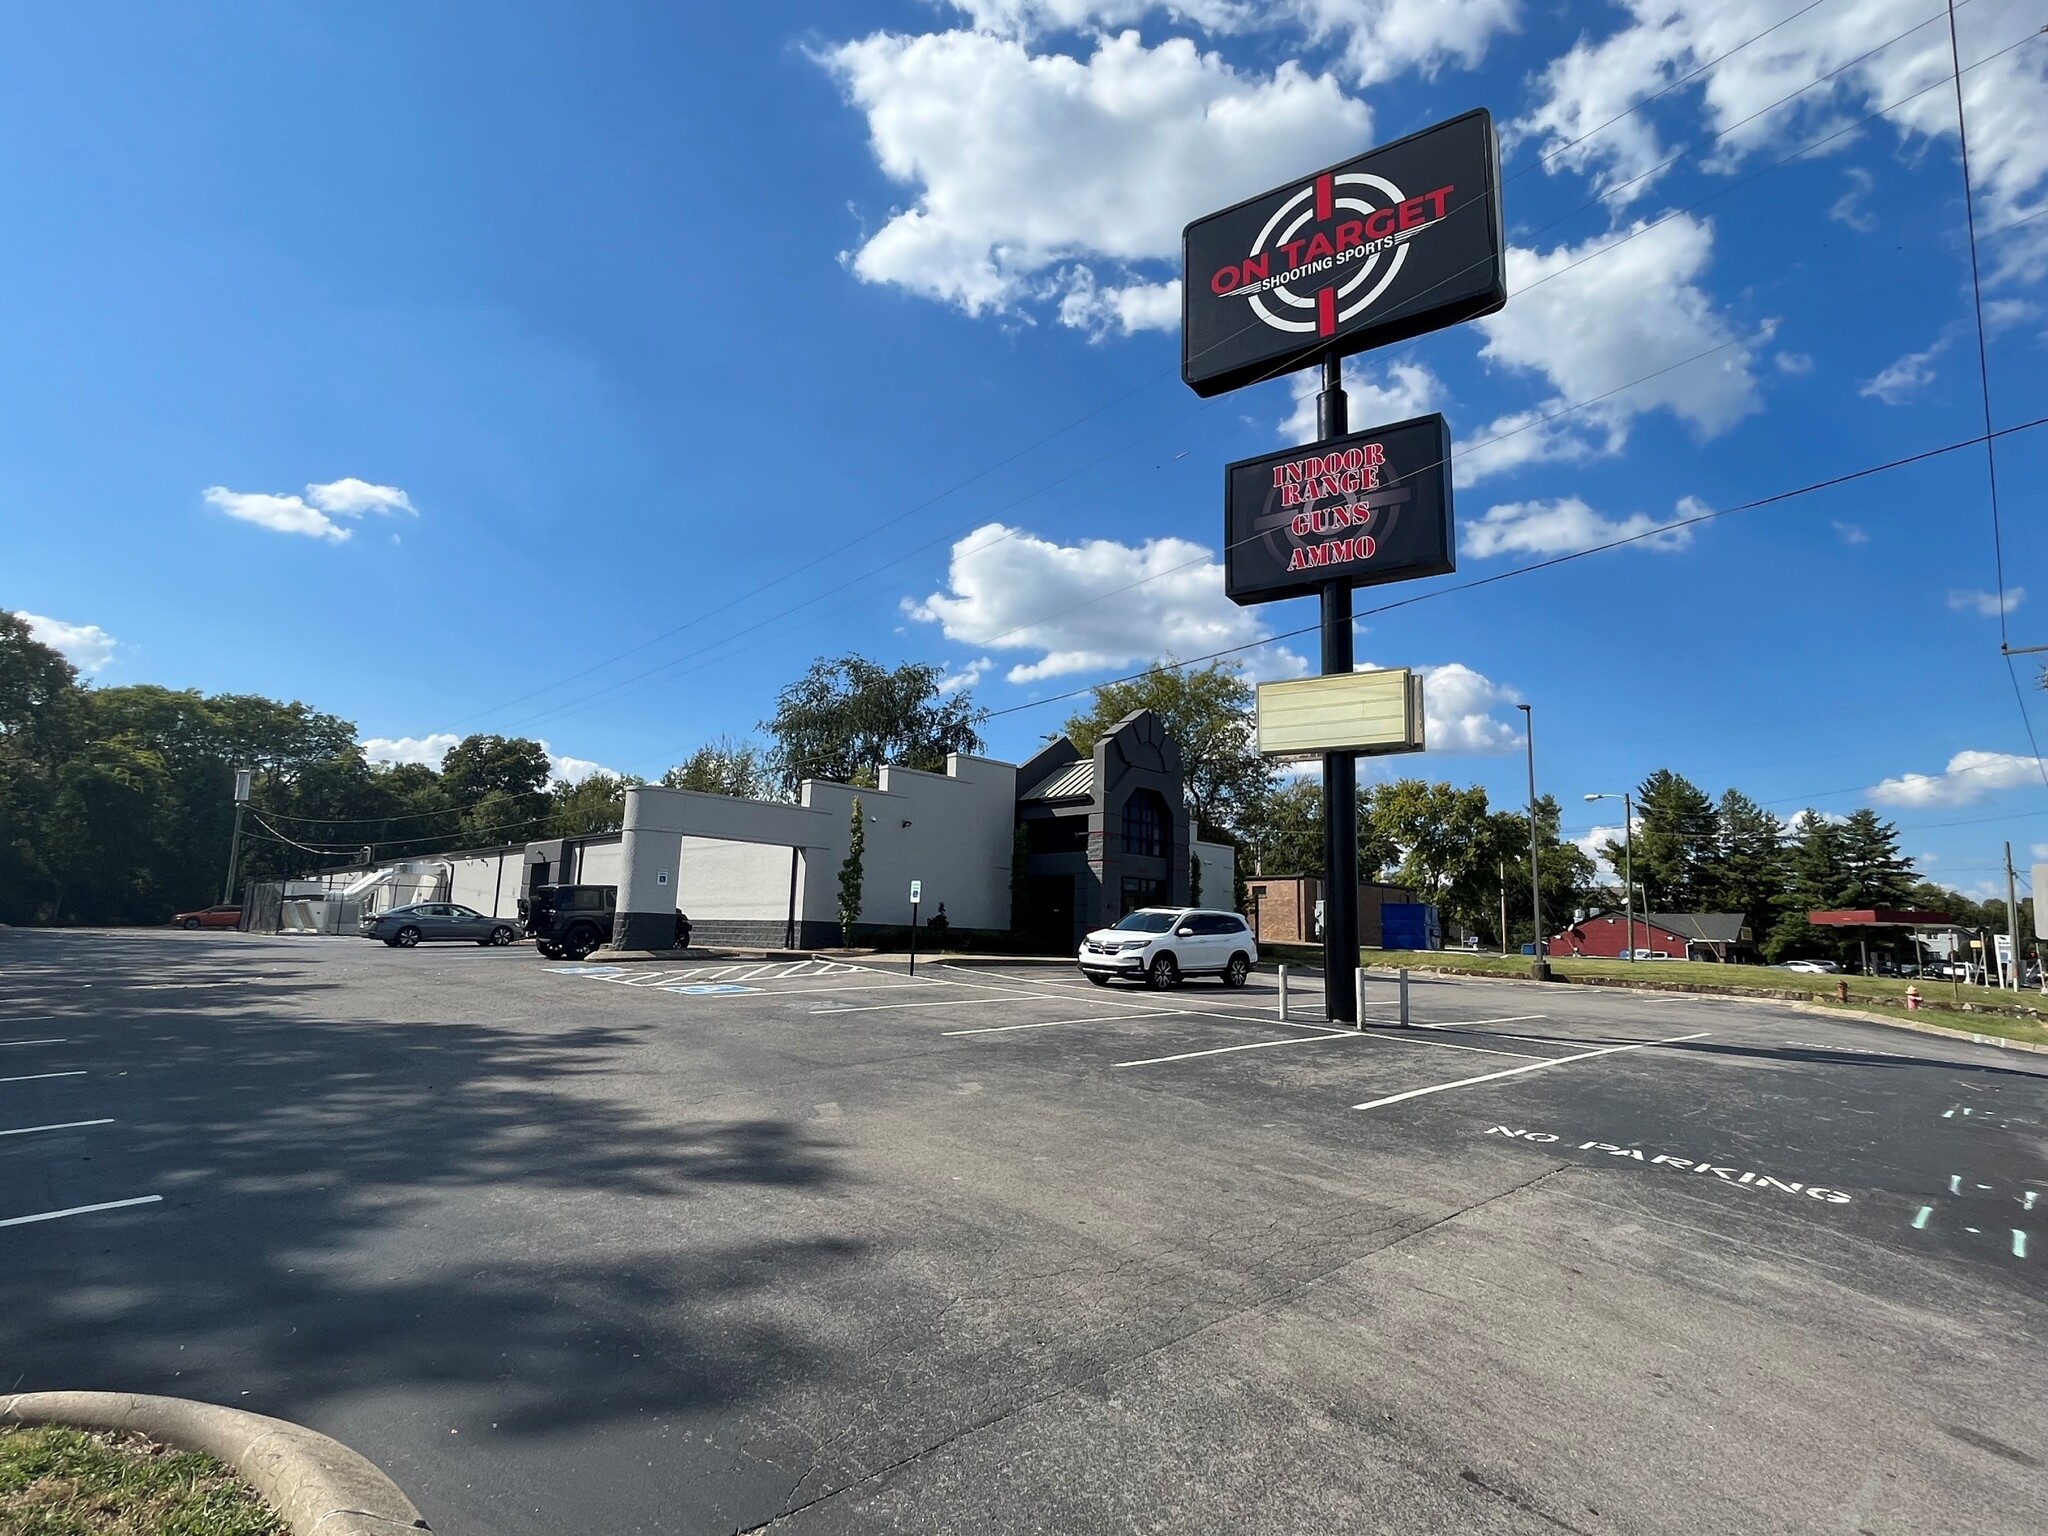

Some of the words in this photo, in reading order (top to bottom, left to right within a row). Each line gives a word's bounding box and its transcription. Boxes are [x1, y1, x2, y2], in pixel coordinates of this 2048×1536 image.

[1211, 252, 1270, 296] ON
[1280, 185, 1454, 269] TARGET
[1261, 257, 1333, 291] SHOOTING
[1336, 235, 1393, 266] SPORTS
[1273, 443, 1386, 488] INDOOR
[1281, 466, 1380, 507] RANGE
[1291, 501, 1371, 536] GUNS
[1286, 536, 1376, 571] AMMO
[1484, 1125, 1560, 1143] NO
[1578, 1141, 1852, 1204] PARKING
